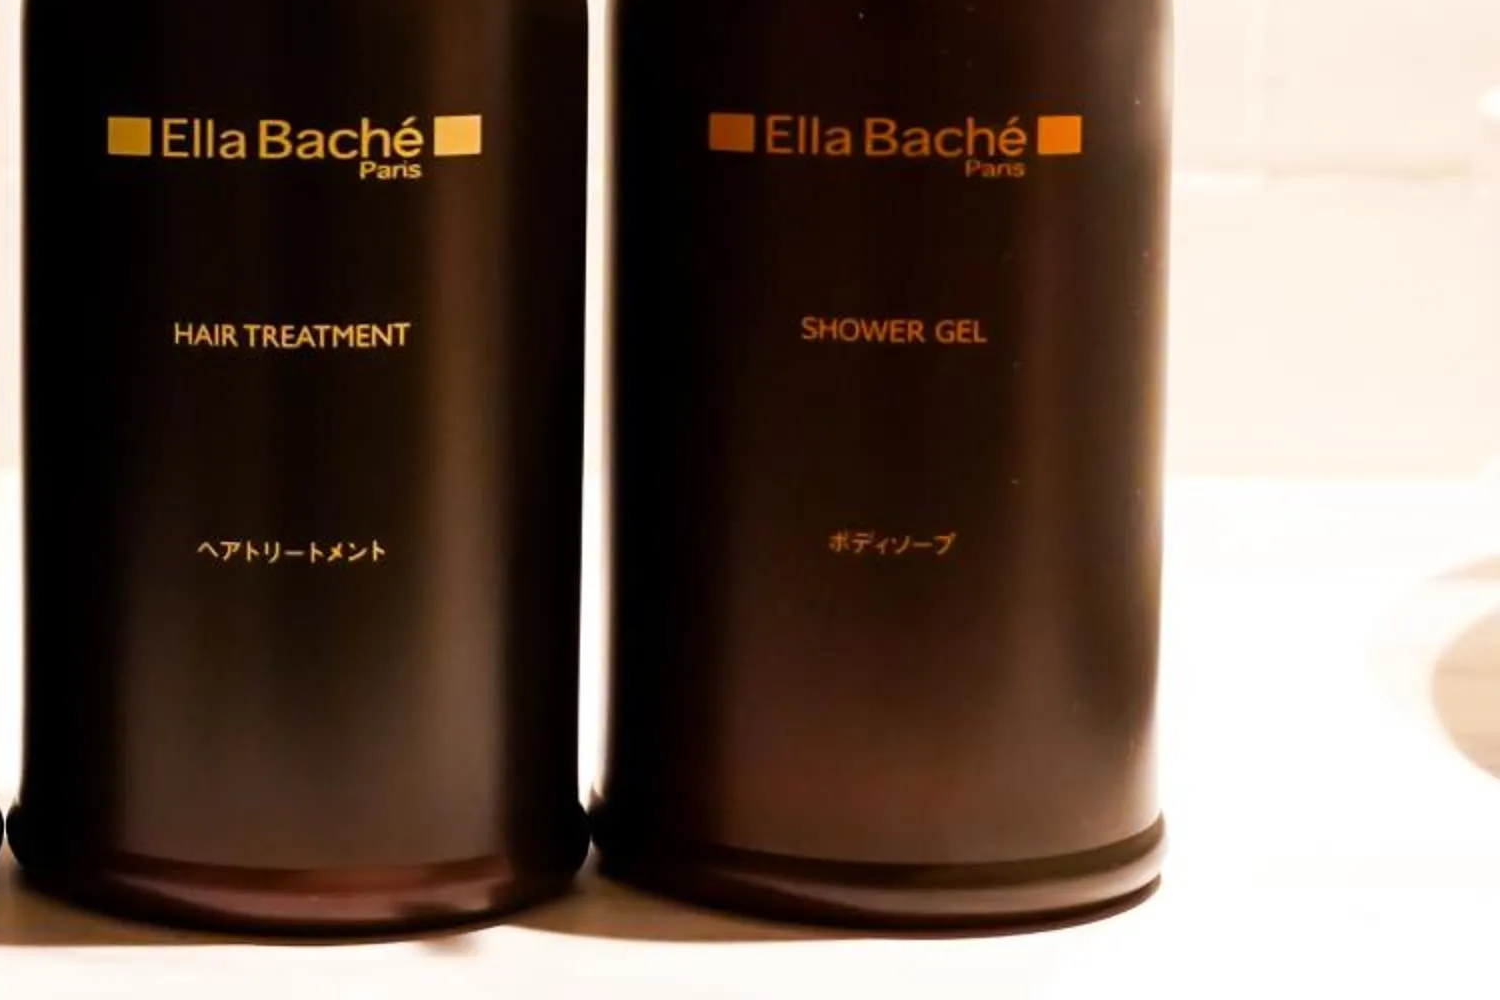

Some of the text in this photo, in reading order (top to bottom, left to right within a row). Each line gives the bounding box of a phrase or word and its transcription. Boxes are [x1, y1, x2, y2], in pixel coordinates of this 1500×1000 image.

[162, 116, 424, 160] Ella Baché
[766, 115, 1028, 157] Ella Baché
[359, 161, 422, 180] Paris
[965, 159, 1026, 179] Paris
[174, 322, 411, 349] HAIR TREATMENT
[801, 316, 987, 344] SHOWER GEL
[197, 540, 386, 564] ヘアトリートメント
[828, 529, 957, 556] ボディソープ
